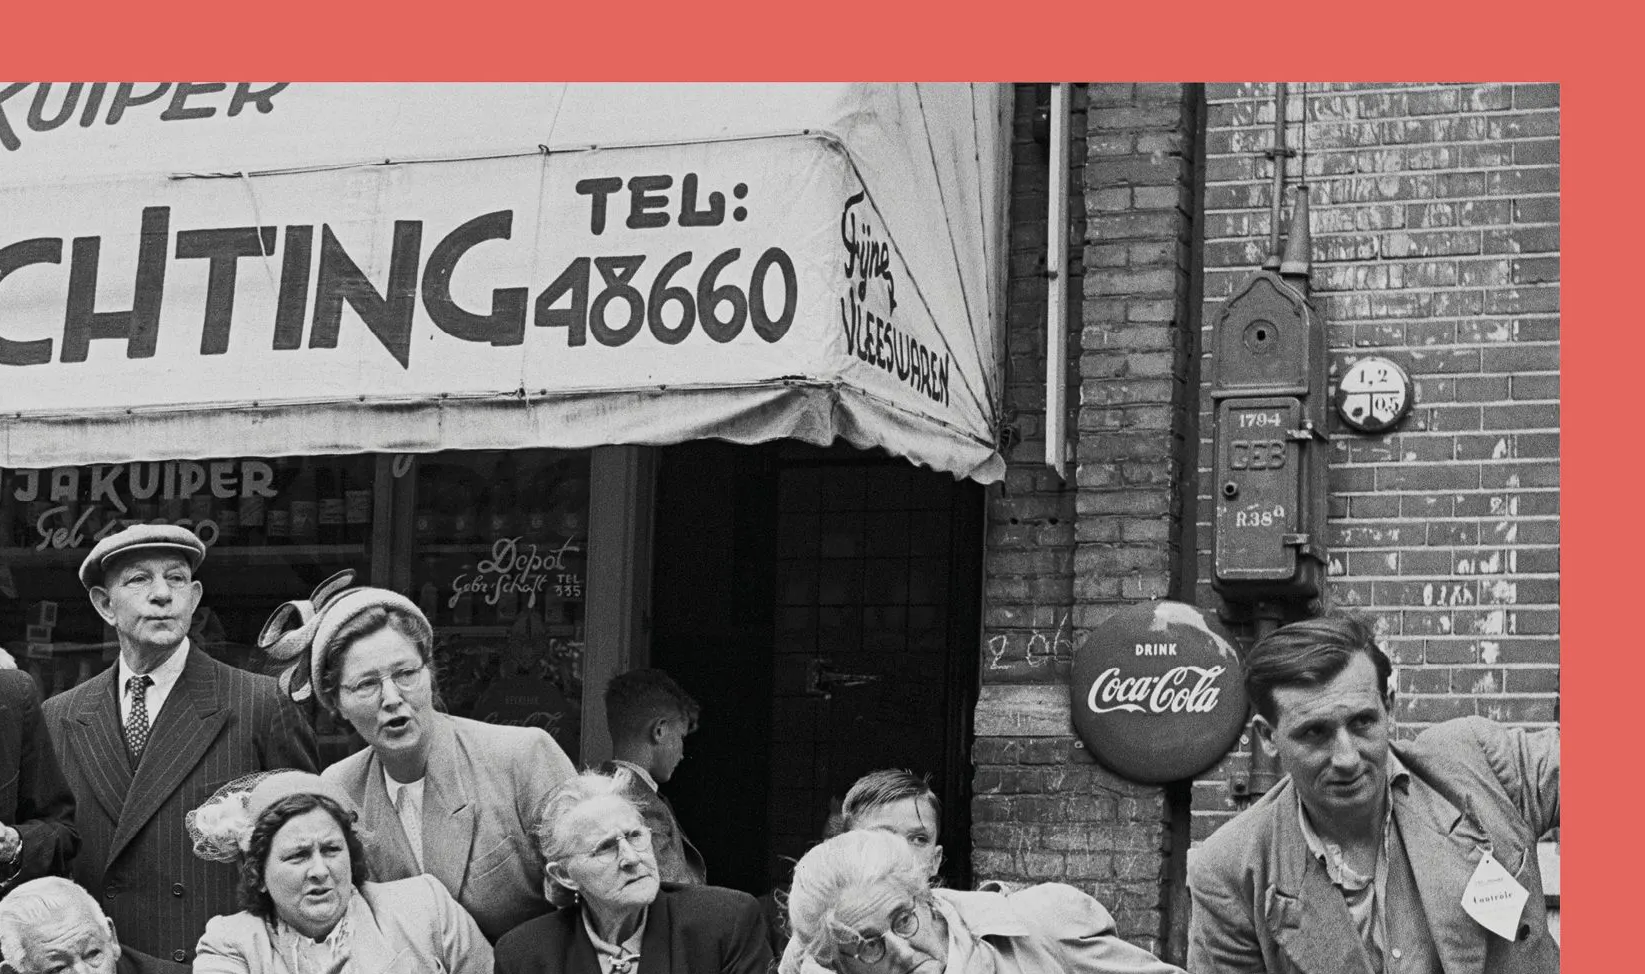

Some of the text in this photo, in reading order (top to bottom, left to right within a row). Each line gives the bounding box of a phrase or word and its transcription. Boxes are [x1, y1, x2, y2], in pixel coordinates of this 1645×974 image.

[575, 172, 749, 236] TEL:
[534, 247, 797, 347] 48660
[841, 286, 949, 408] VLEESWAREN
[1239, 413, 1281, 427] 1794
[557, 574, 580, 584] TEL
[1135, 643, 1177, 656] DRINK
[1087, 665, 1226, 713] Coca-Cola
